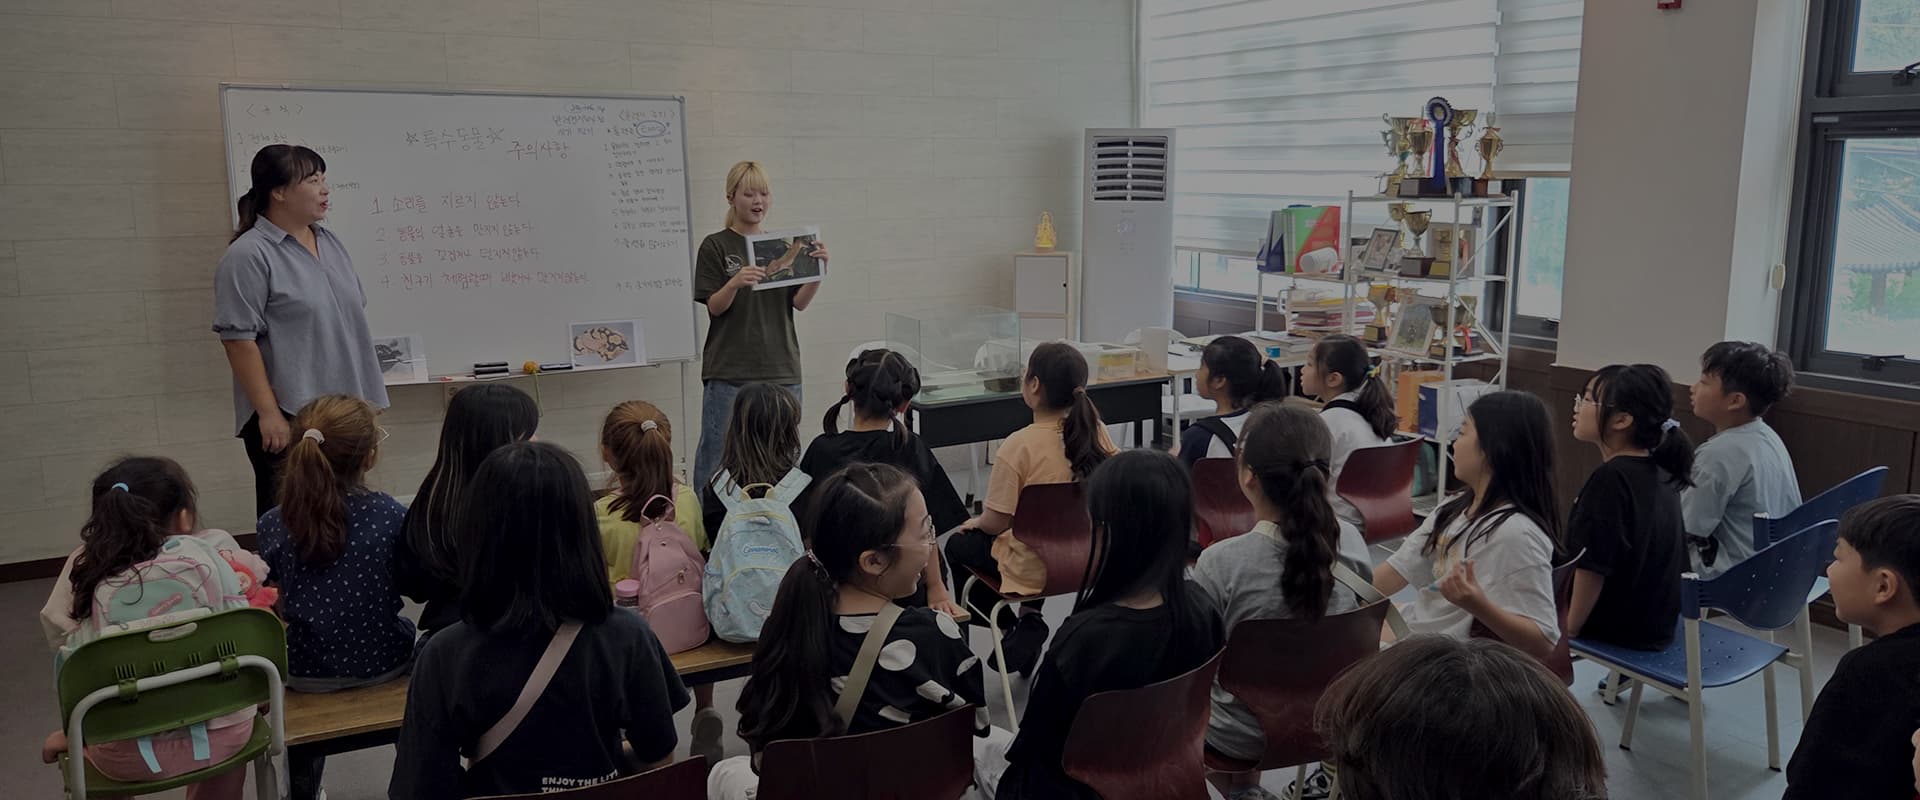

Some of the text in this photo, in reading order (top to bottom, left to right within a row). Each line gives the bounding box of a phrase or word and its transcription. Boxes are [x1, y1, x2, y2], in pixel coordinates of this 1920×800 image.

[423, 128, 488, 152] 특수동물
[507, 139, 569, 161] 주의사항
[393, 193, 429, 214] 소리를
[440, 192, 478, 209] 지르지
[487, 192, 521, 211] 않는다
[400, 272, 434, 291] 친구가
[542, 776, 576, 787] ENJOY
[577, 778, 599, 786] THE
